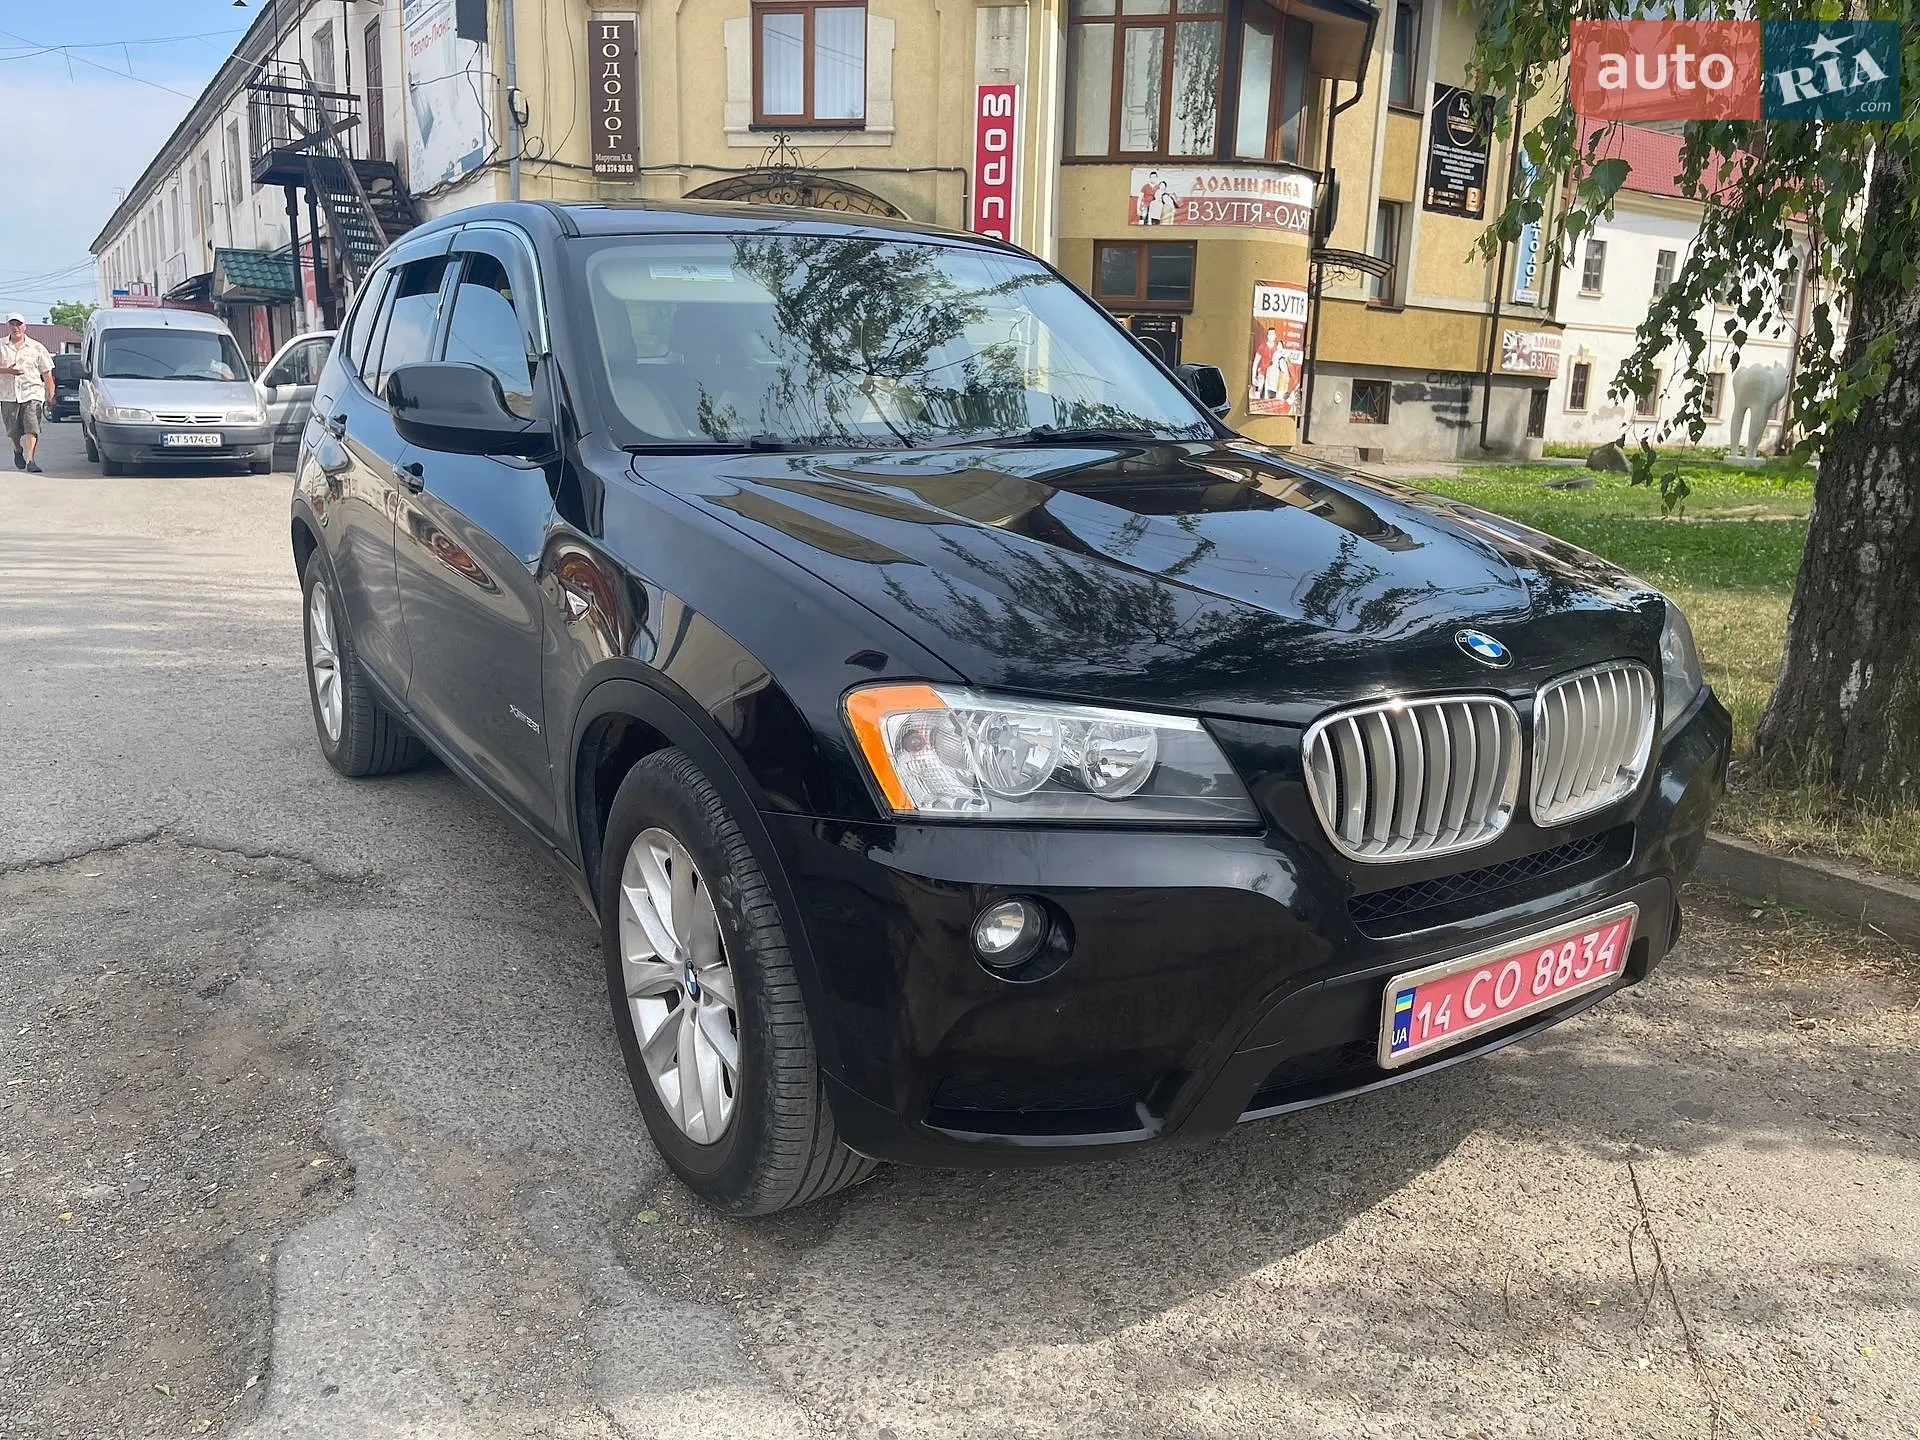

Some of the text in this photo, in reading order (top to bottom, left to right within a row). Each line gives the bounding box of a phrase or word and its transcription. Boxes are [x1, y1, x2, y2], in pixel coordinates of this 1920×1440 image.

[601, 25, 623, 149] ПОДОЛОГ
[1458, 97, 1471, 118] KS
[1190, 175, 1301, 199] ДОЛИНЯНКА
[1187, 201, 1263, 223] ВЗУТТЯ
[1262, 293, 1305, 315] ВЗУТТЯ
[169, 435, 181, 444] AT
[184, 435, 204, 444] 5174
[1417, 924, 1621, 1039] 14 CO 8834
[1391, 1026, 1408, 1046] UA
